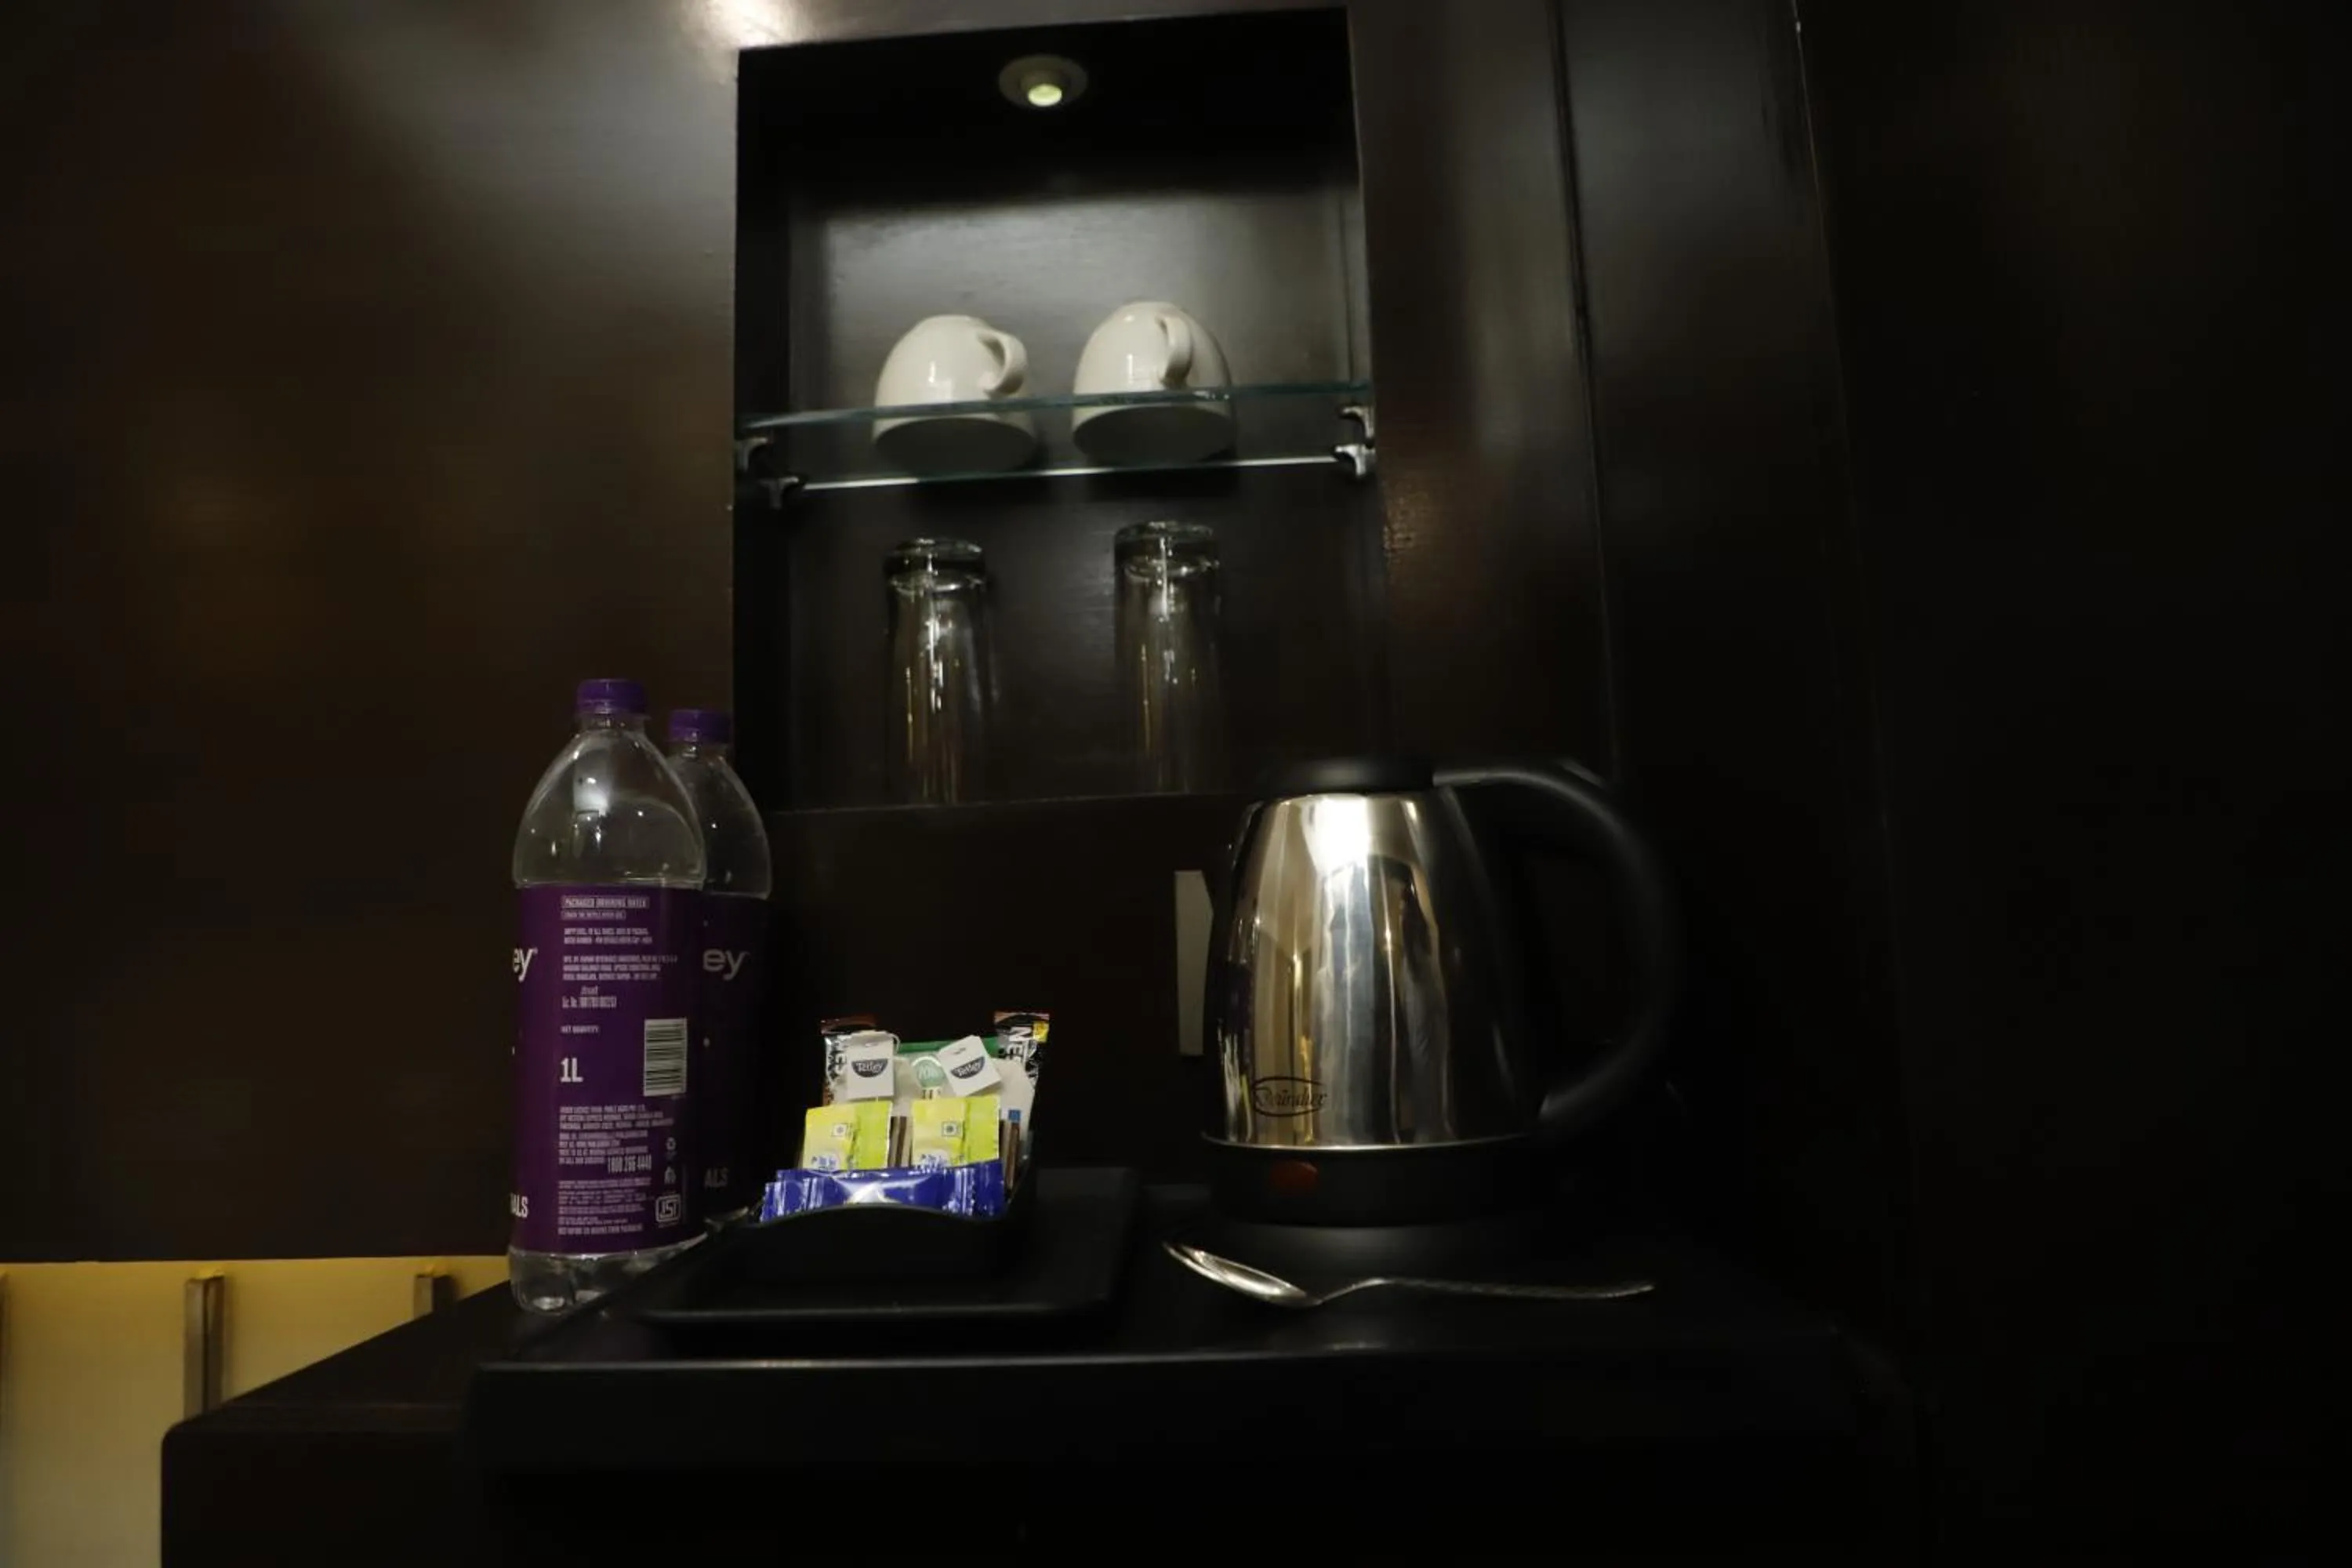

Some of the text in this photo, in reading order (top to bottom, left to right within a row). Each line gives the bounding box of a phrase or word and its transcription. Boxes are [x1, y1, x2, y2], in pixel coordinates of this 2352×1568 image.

[560, 1057, 584, 1083] 1L
[855, 1061, 883, 1073] Tetley
[956, 1061, 982, 1076] Tetley
